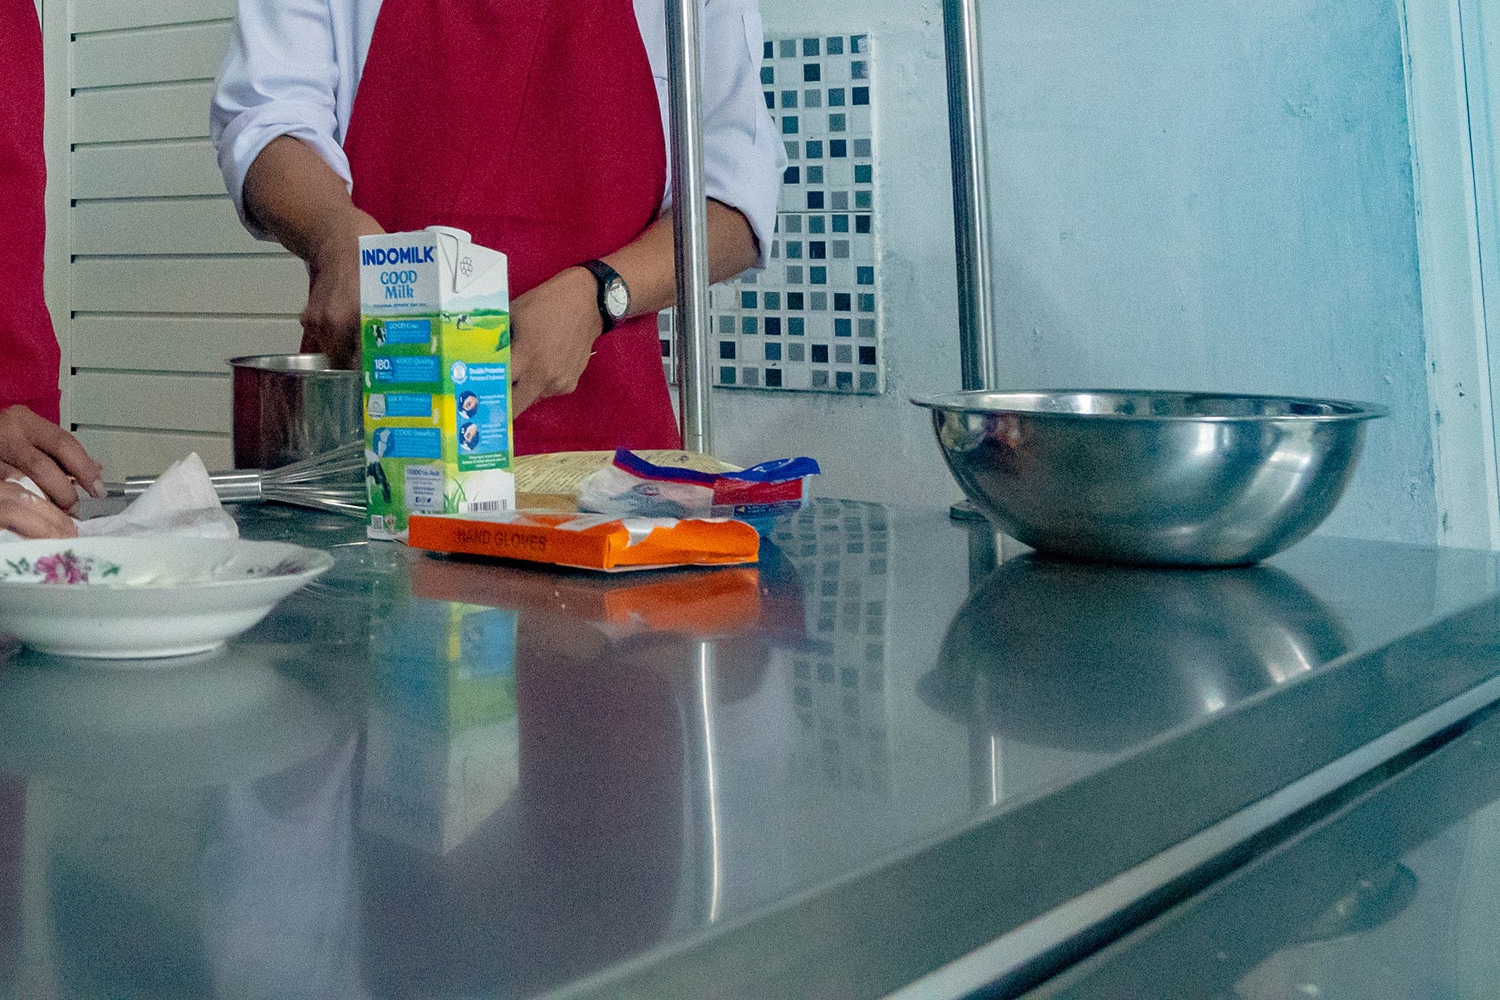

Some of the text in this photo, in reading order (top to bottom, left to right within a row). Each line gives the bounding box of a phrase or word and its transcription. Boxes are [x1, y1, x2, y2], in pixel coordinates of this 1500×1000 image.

[362, 246, 435, 266] INDOMILK
[380, 269, 418, 285] GOOD
[384, 284, 414, 299] Milk
[374, 358, 390, 370] 180
[457, 528, 546, 552] HAND GLOVES
